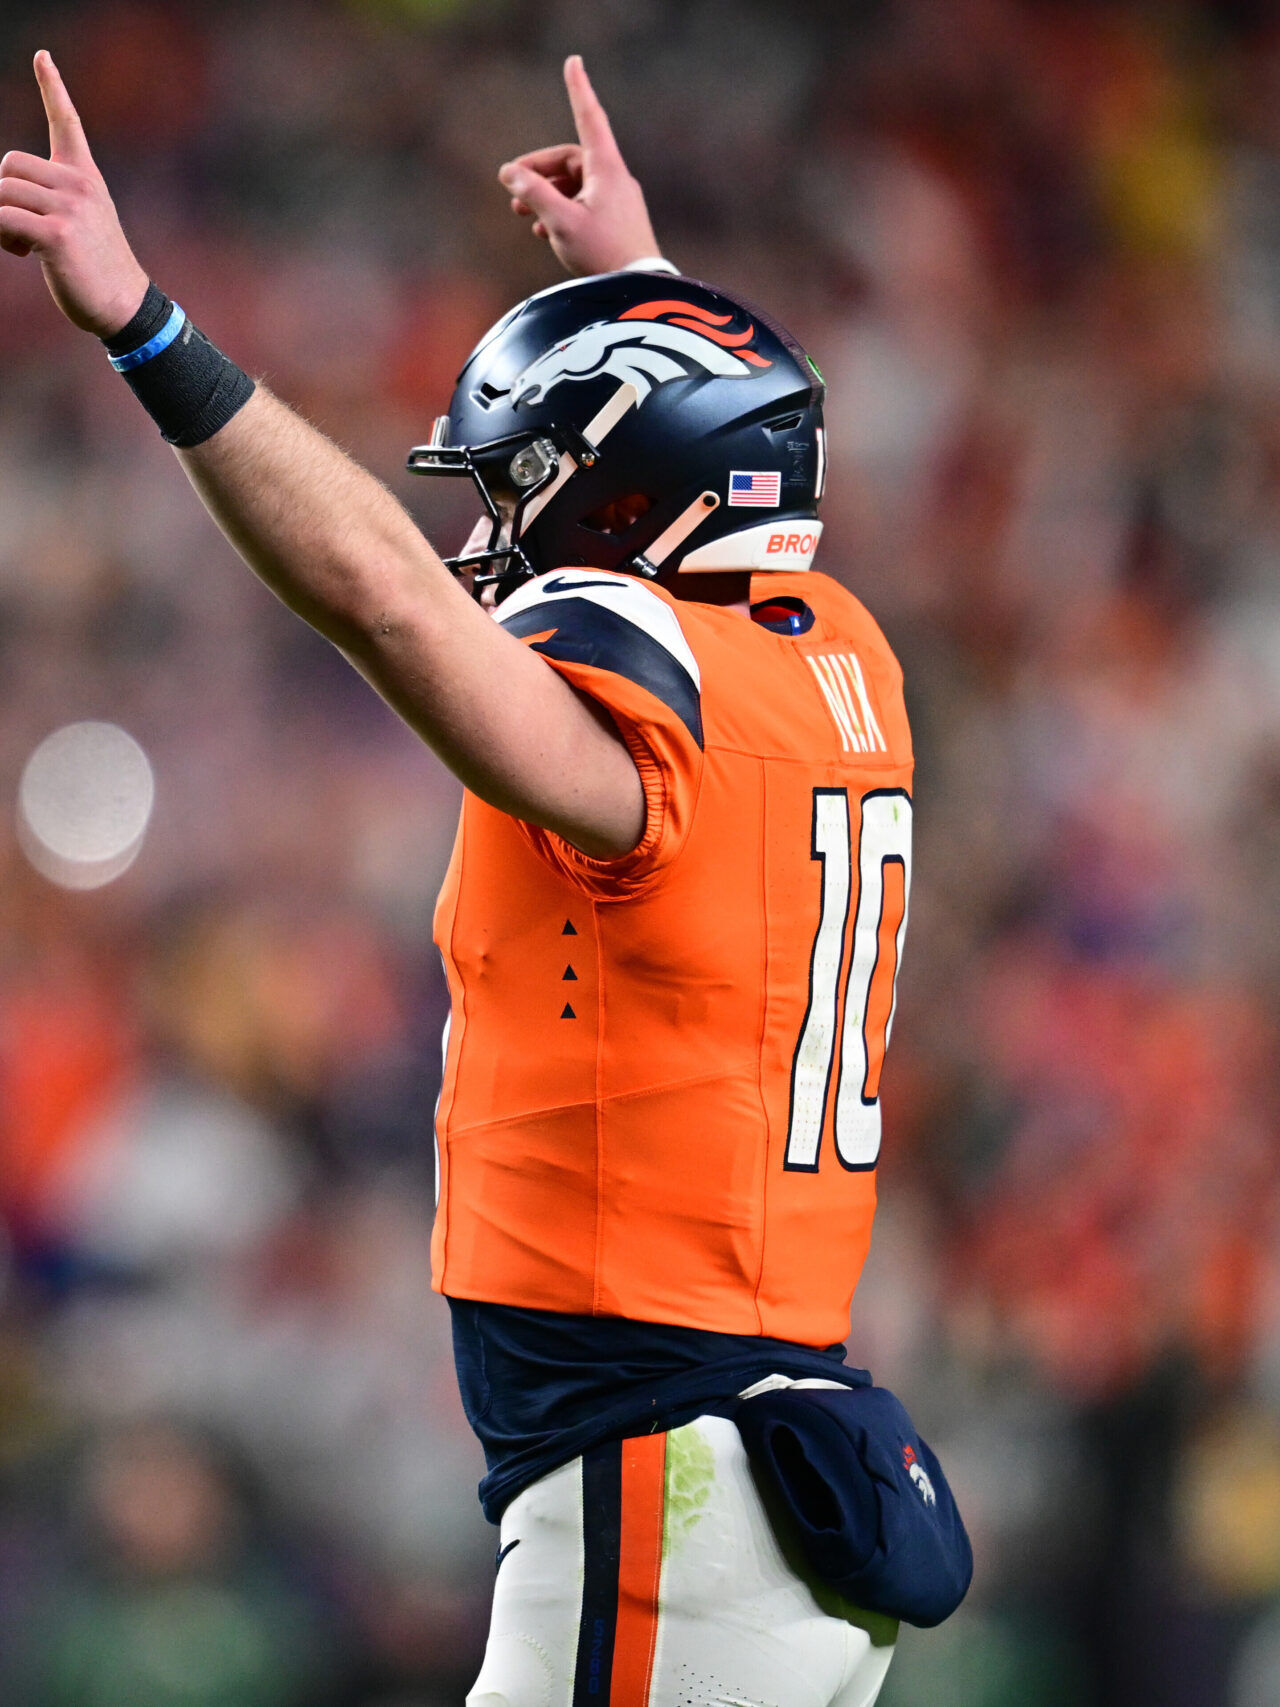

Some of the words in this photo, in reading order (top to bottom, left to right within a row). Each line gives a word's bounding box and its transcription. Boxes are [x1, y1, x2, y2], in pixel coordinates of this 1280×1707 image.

[806, 653, 887, 752] NIX
[783, 787, 913, 1172] 10
[588, 1618, 605, 1694] 5280
